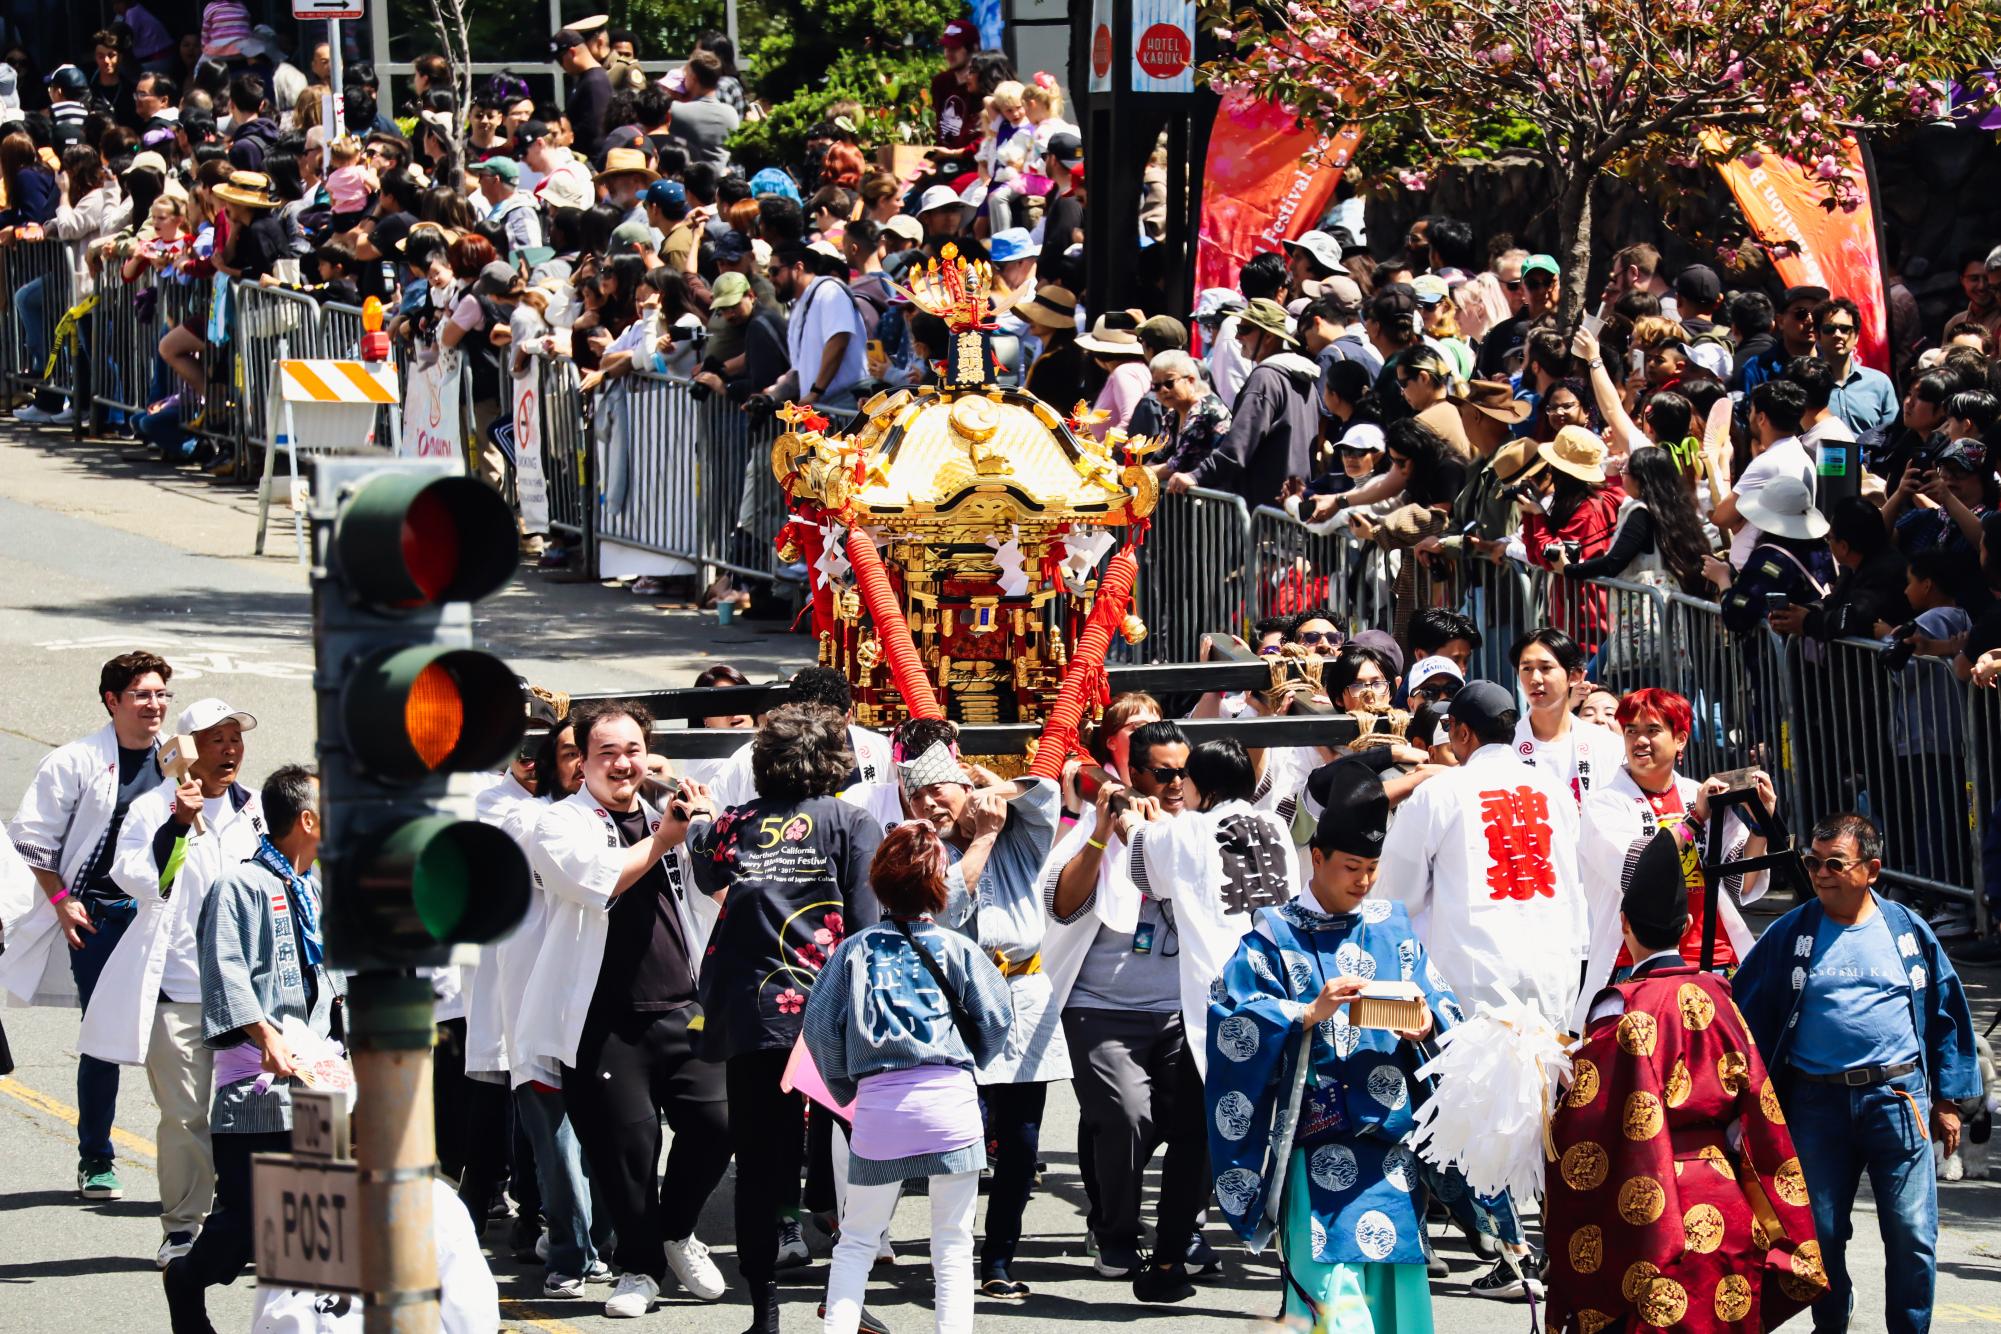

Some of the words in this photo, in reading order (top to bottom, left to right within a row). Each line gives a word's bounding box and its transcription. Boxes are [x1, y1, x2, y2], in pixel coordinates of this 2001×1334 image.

[1147, 38, 1180, 51] HOTEL
[1261, 169, 1313, 247] Festival
[757, 813, 814, 848] 50
[739, 861, 763, 870] herry
[763, 858, 796, 867] Blossom
[797, 857, 827, 865] Festival
[749, 849, 780, 860] Northern
[781, 846, 816, 855] California
[282, 1191, 346, 1263] POST
